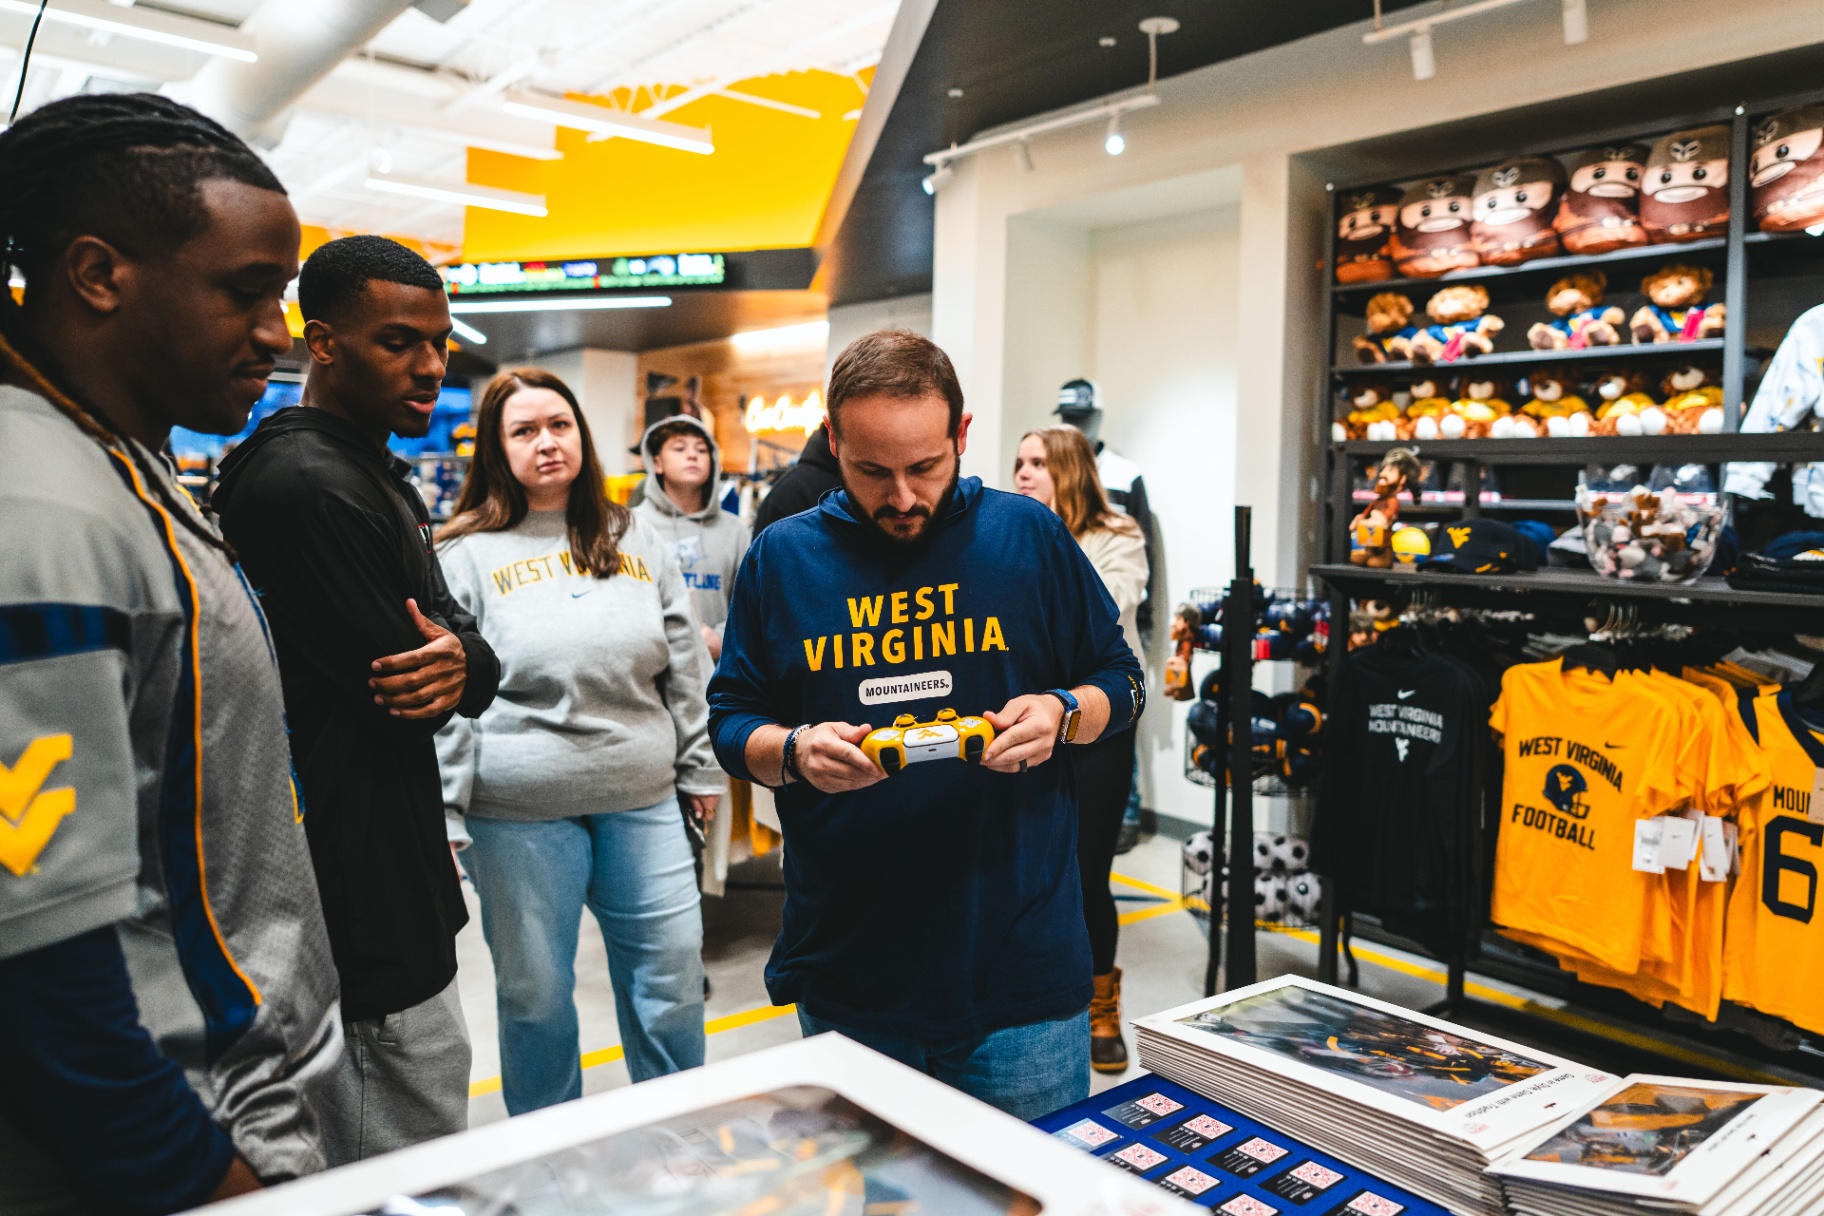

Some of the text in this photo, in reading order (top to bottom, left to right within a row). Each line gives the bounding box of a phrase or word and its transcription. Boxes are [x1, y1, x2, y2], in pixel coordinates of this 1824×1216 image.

[492, 550, 654, 596] WEST VNIA
[847, 582, 959, 628] WEST
[803, 616, 1007, 672] VIRGINIA
[1368, 703, 1443, 730] WEST VIRGINIA
[1368, 719, 1442, 745] MOUNTAINEERS
[1519, 736, 1623, 794] WEST VIRGINIA
[1511, 803, 1595, 851] FOOTBALL
[1762, 815, 1824, 924] 6
